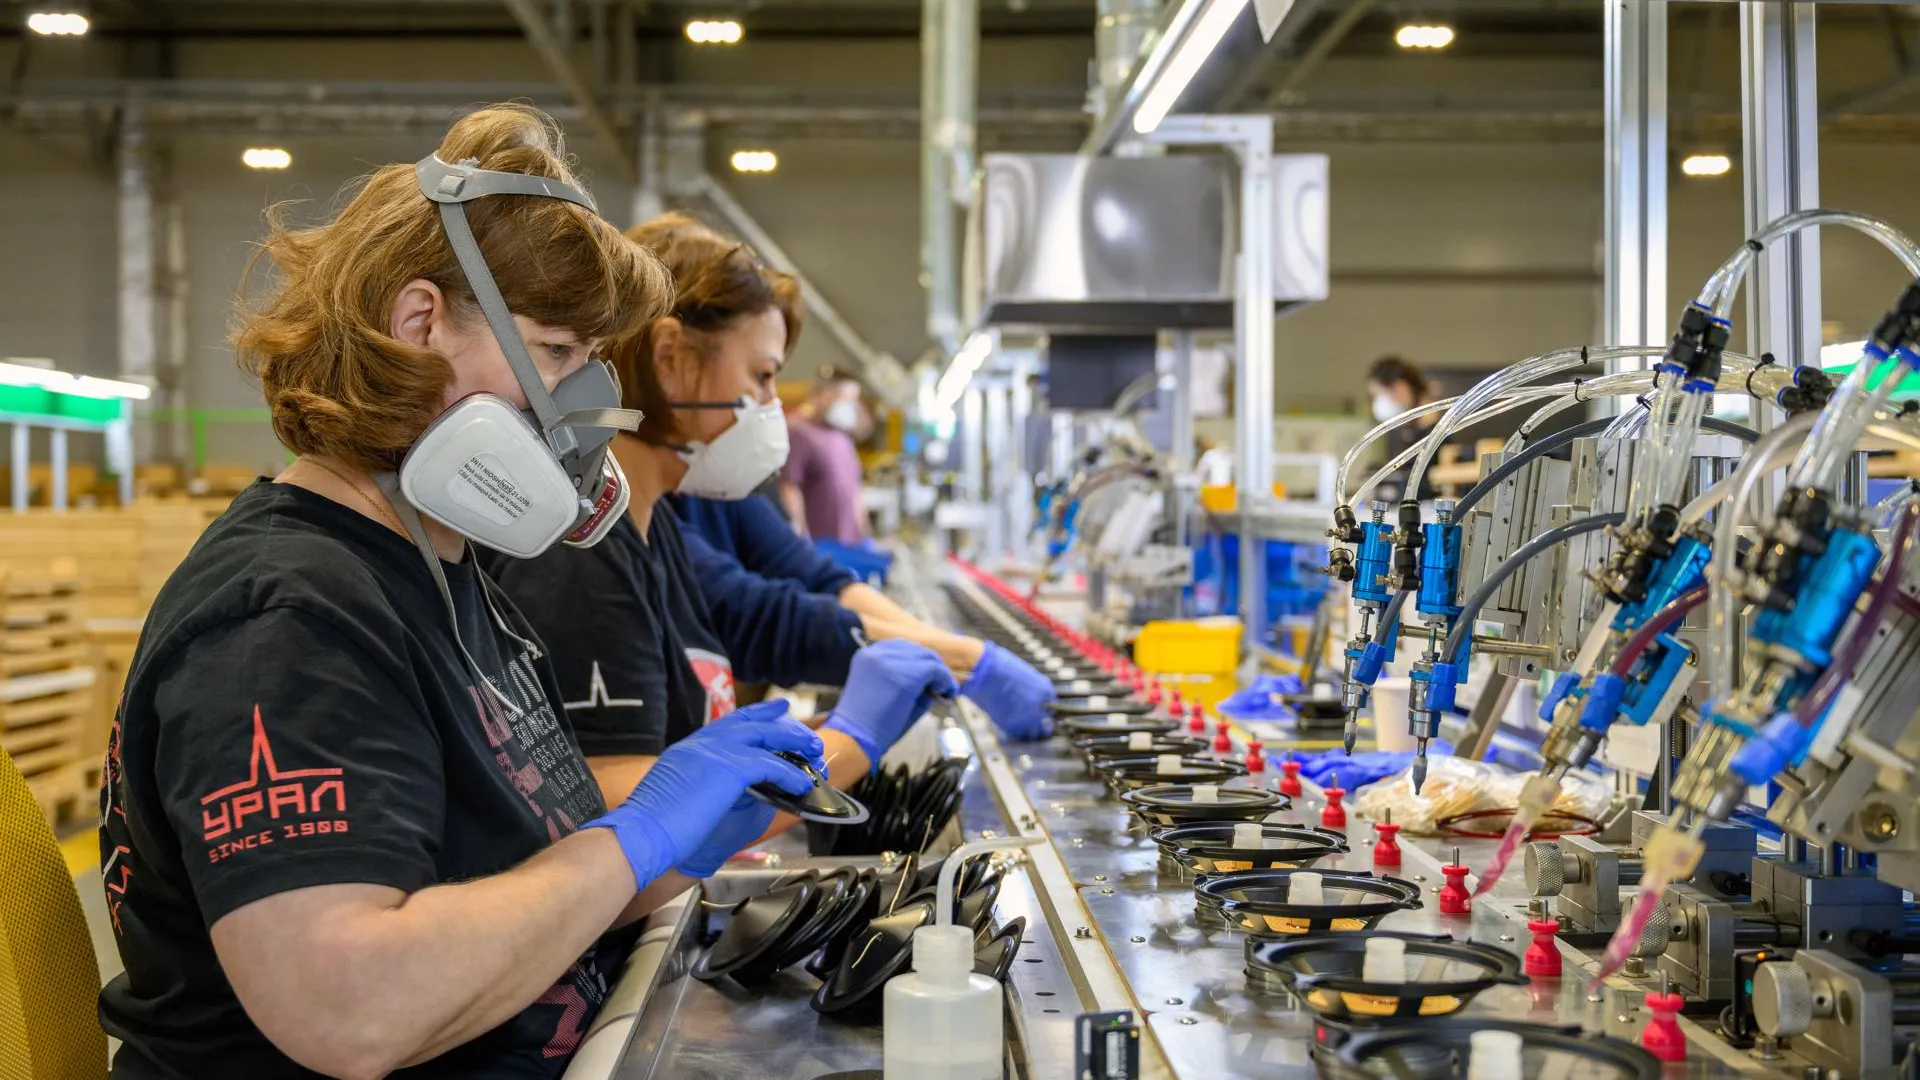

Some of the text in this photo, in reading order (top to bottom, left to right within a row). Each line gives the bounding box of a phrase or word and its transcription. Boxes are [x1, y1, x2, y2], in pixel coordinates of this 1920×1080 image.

[483, 467, 501, 484] NIOSH
[202, 780, 346, 841] УРАЛ
[208, 819, 349, 864] SINCE 1900
